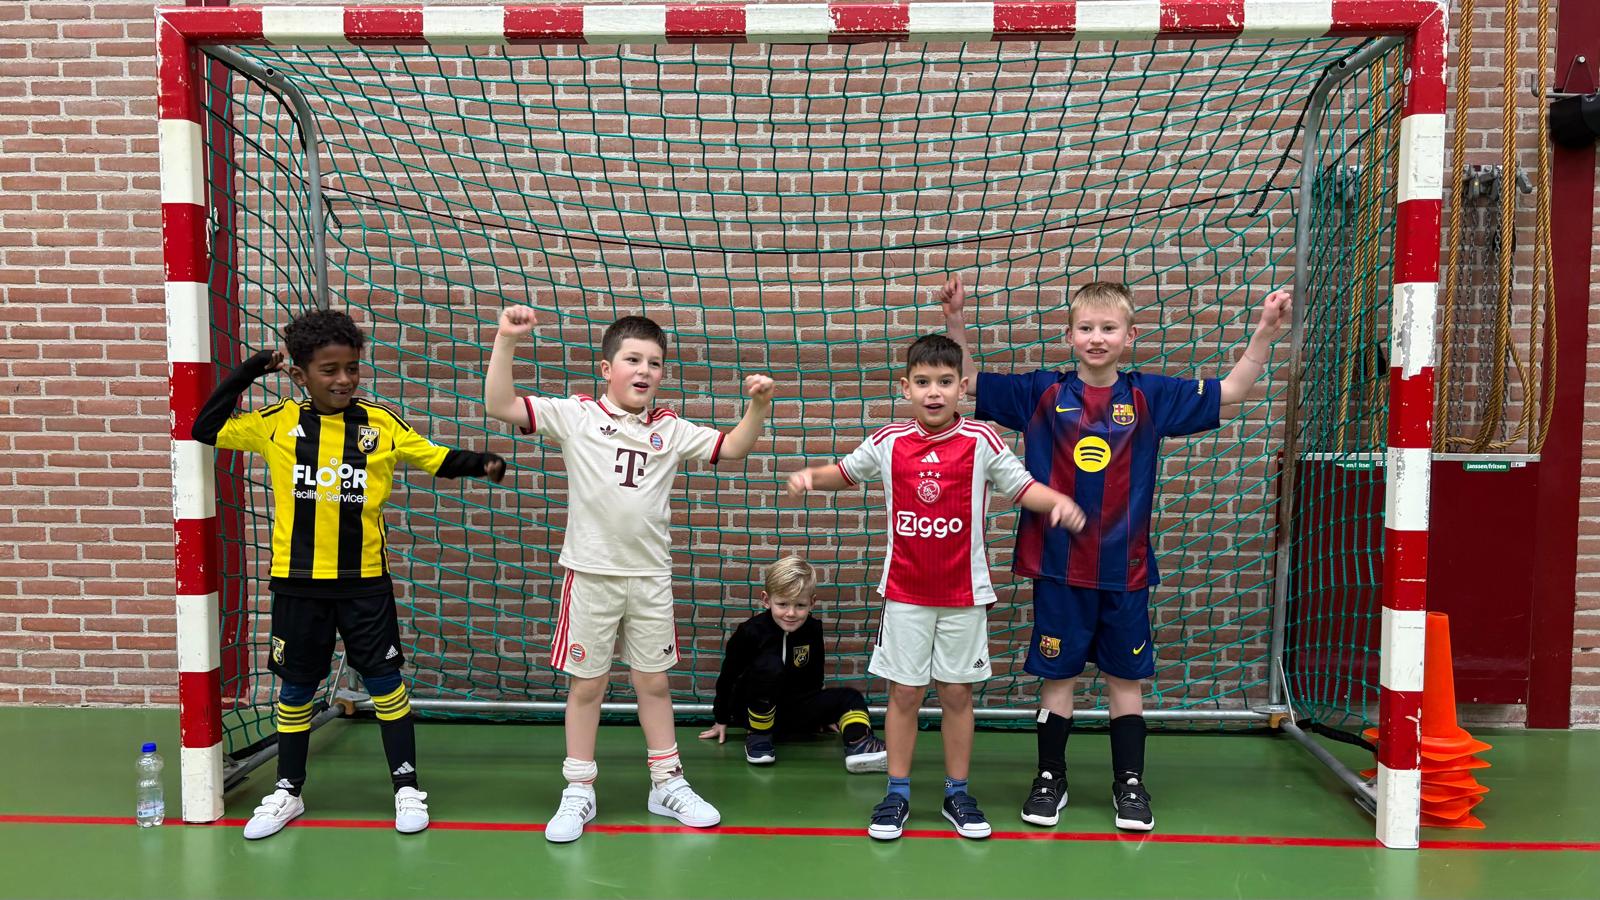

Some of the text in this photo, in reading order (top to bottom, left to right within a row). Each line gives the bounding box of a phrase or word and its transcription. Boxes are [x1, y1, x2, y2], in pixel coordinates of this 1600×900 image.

[292, 463, 368, 489] FLOOR
[615, 448, 648, 488] T
[292, 488, 368, 503] Facility Services
[896, 510, 963, 539] Ziggo
